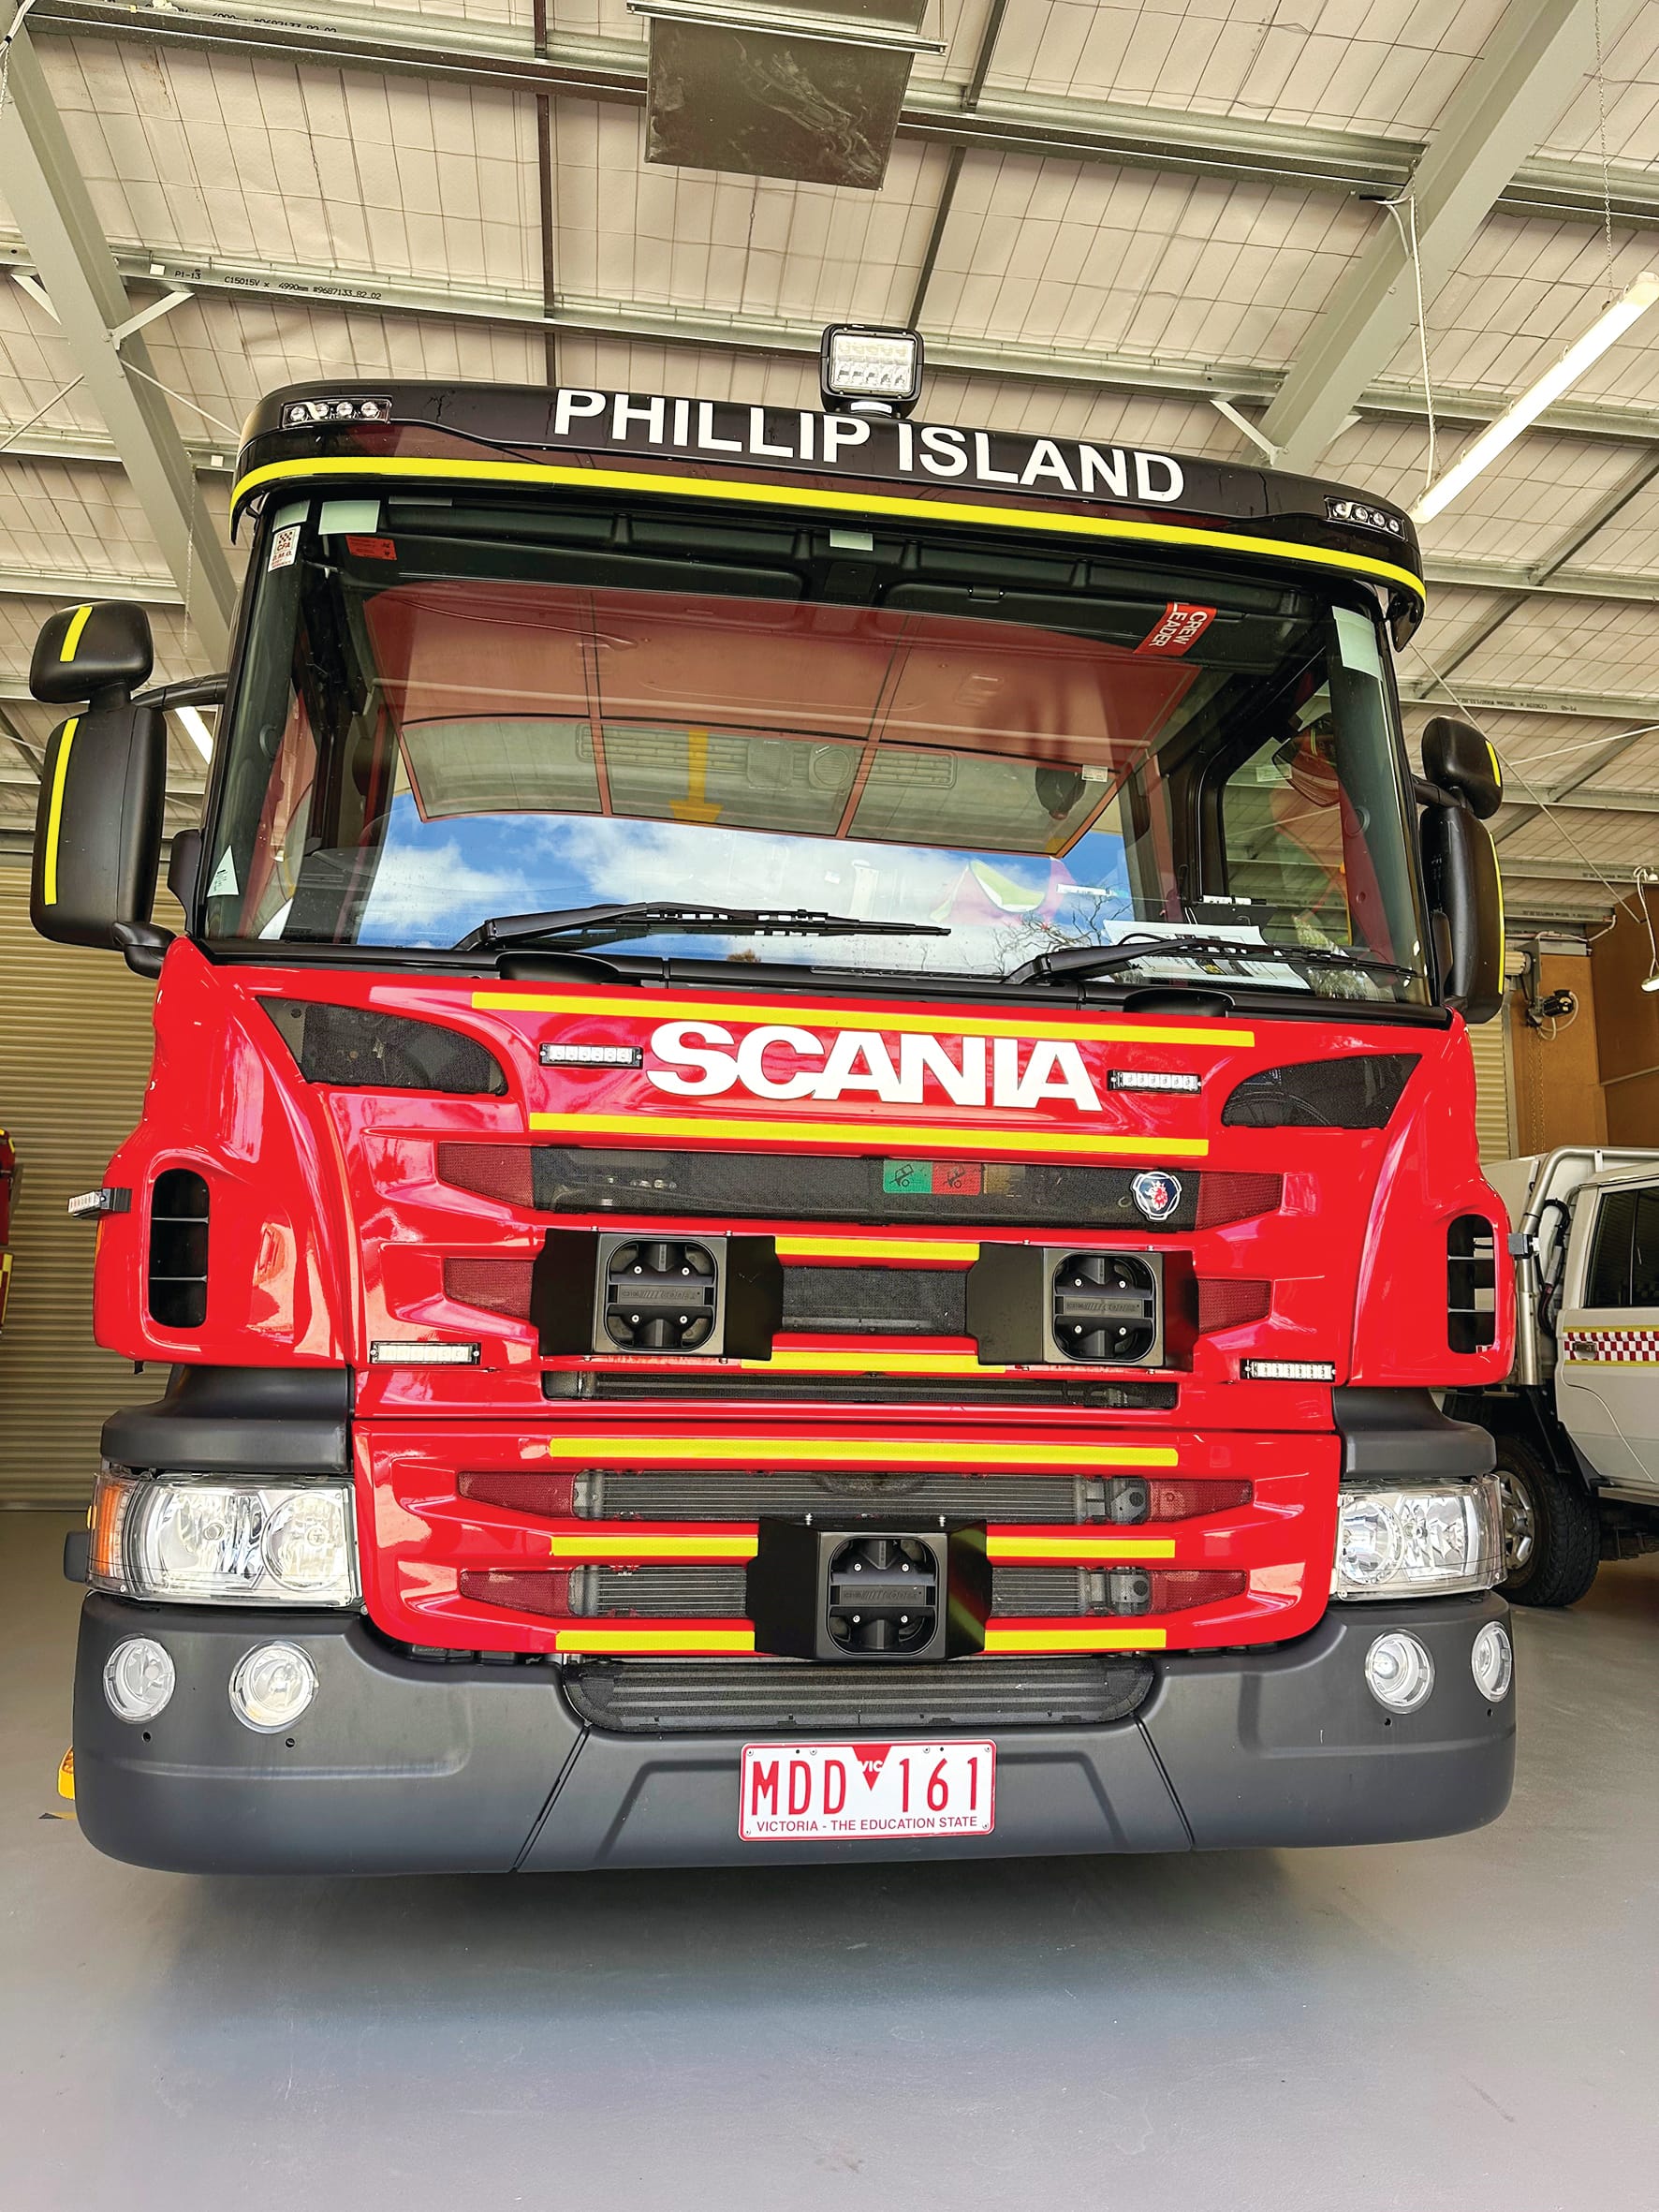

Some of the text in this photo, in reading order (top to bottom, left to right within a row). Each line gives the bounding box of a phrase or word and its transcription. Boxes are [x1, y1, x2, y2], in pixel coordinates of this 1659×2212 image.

[553, 388, 1185, 504] PHILLIP ISLAND
[1148, 601, 1190, 647] LEADER
[1172, 611, 1208, 645] CREW
[645, 1021, 1103, 1113] SCANIA
[751, 1757, 978, 1816] MDD 161
[857, 1759, 884, 1773] VIC
[756, 1820, 818, 1832] VICTORIA
[830, 1820, 857, 1831] THE
[860, 1818, 935, 1830] EDUCATION
[938, 1816, 978, 1827] STATE
